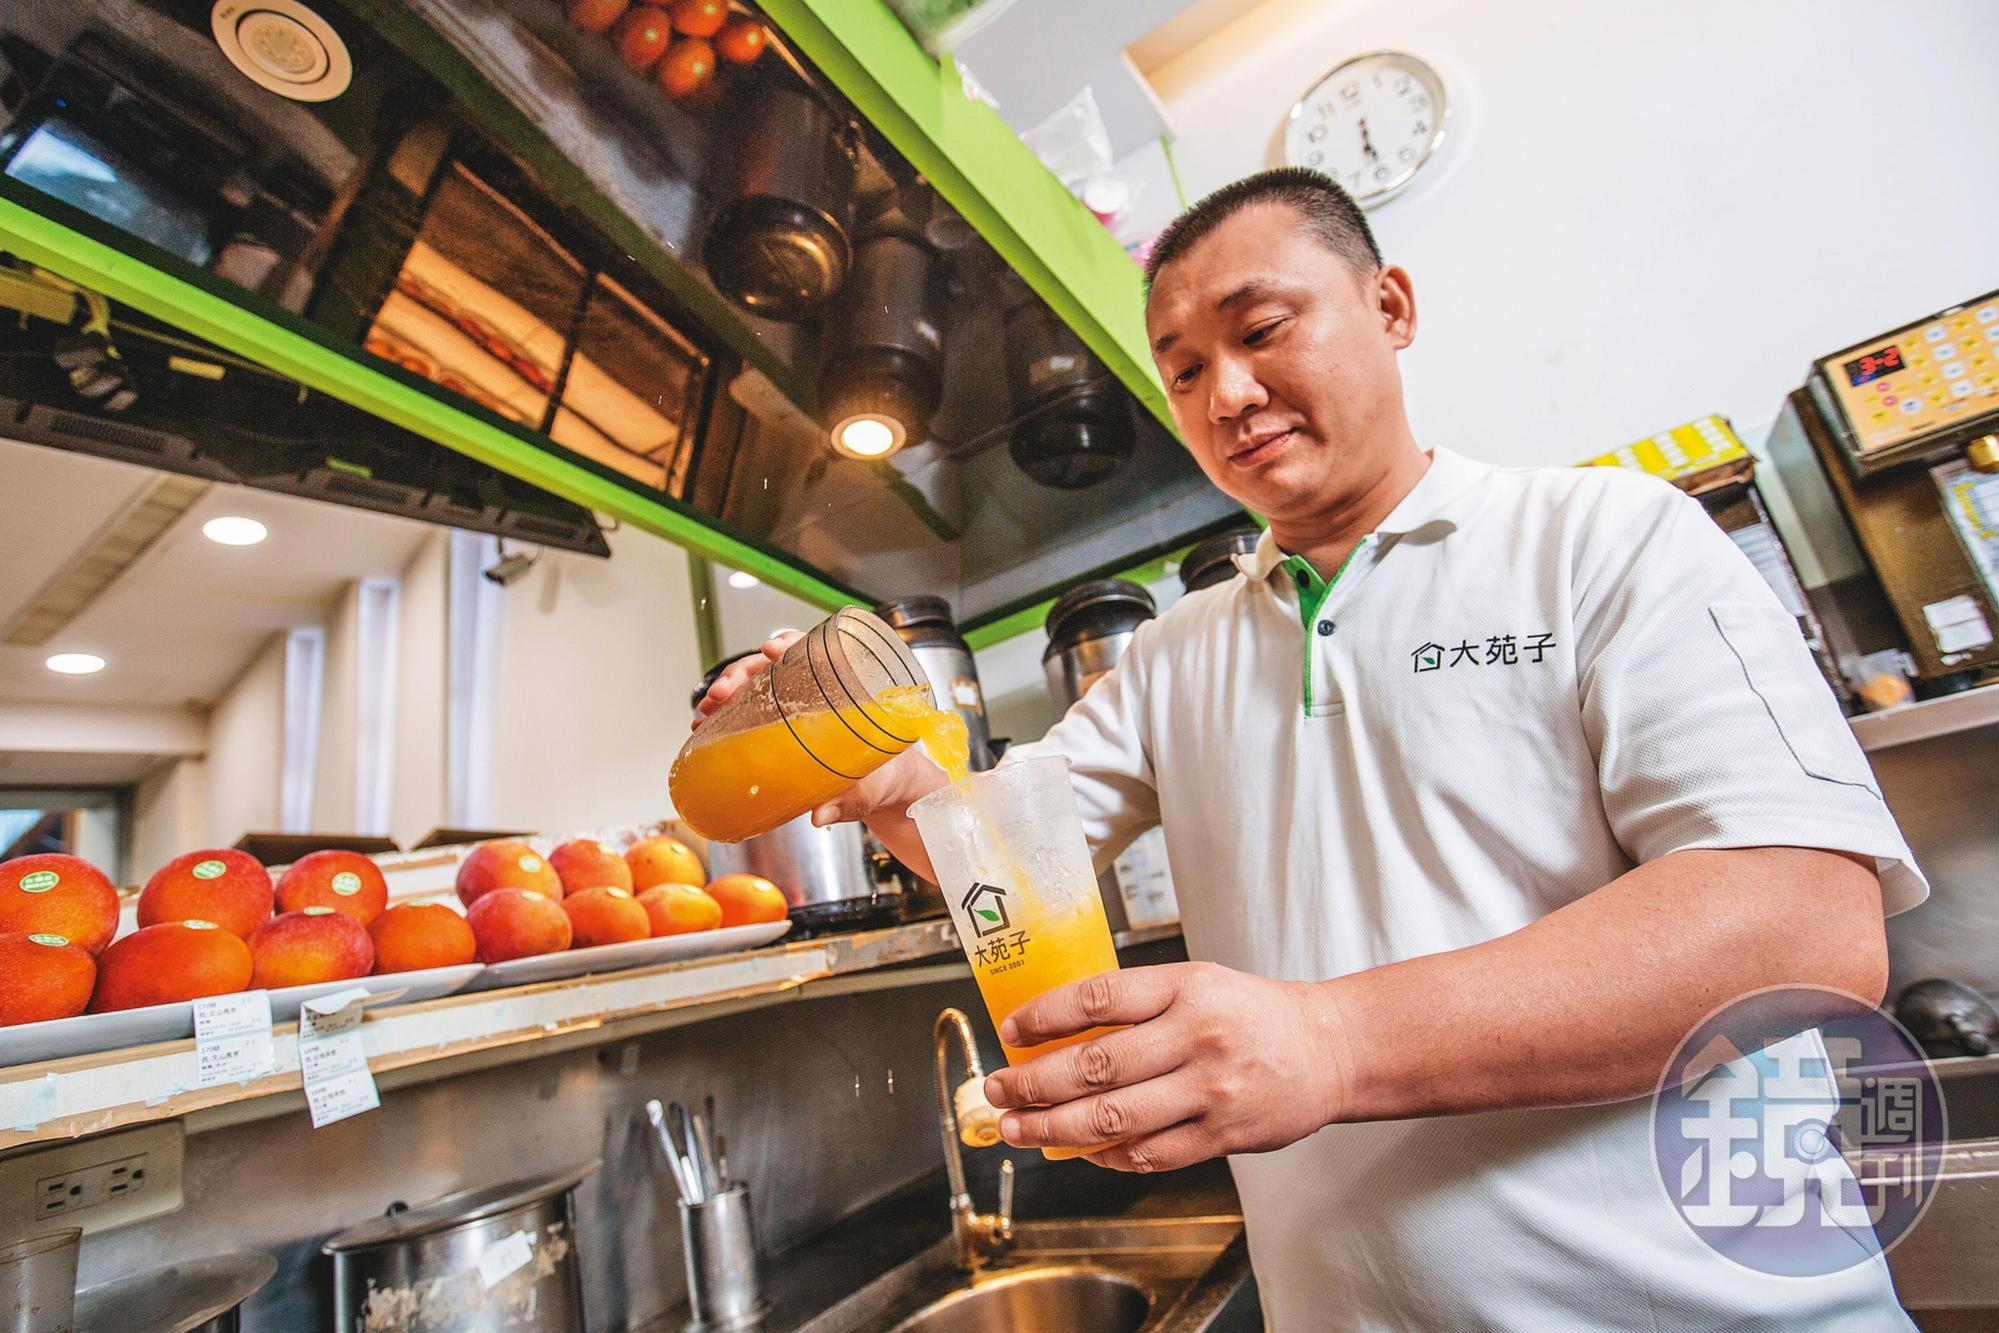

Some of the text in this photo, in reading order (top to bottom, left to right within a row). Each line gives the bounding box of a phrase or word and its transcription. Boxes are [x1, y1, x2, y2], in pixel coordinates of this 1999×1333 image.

[1340, 80, 1360, 100] 12
[1394, 77, 1411, 95] 2
[1307, 124, 1328, 144] 10
[1413, 119, 1428, 136] 4
[1308, 150, 1325, 166] 9
[1347, 171, 1362, 188] 7
[1374, 163, 1391, 181] 6
[1450, 632, 1557, 668] 大苑子
[975, 930, 1030, 967] 大苑子
[989, 959, 1025, 976] SINCE 2001
